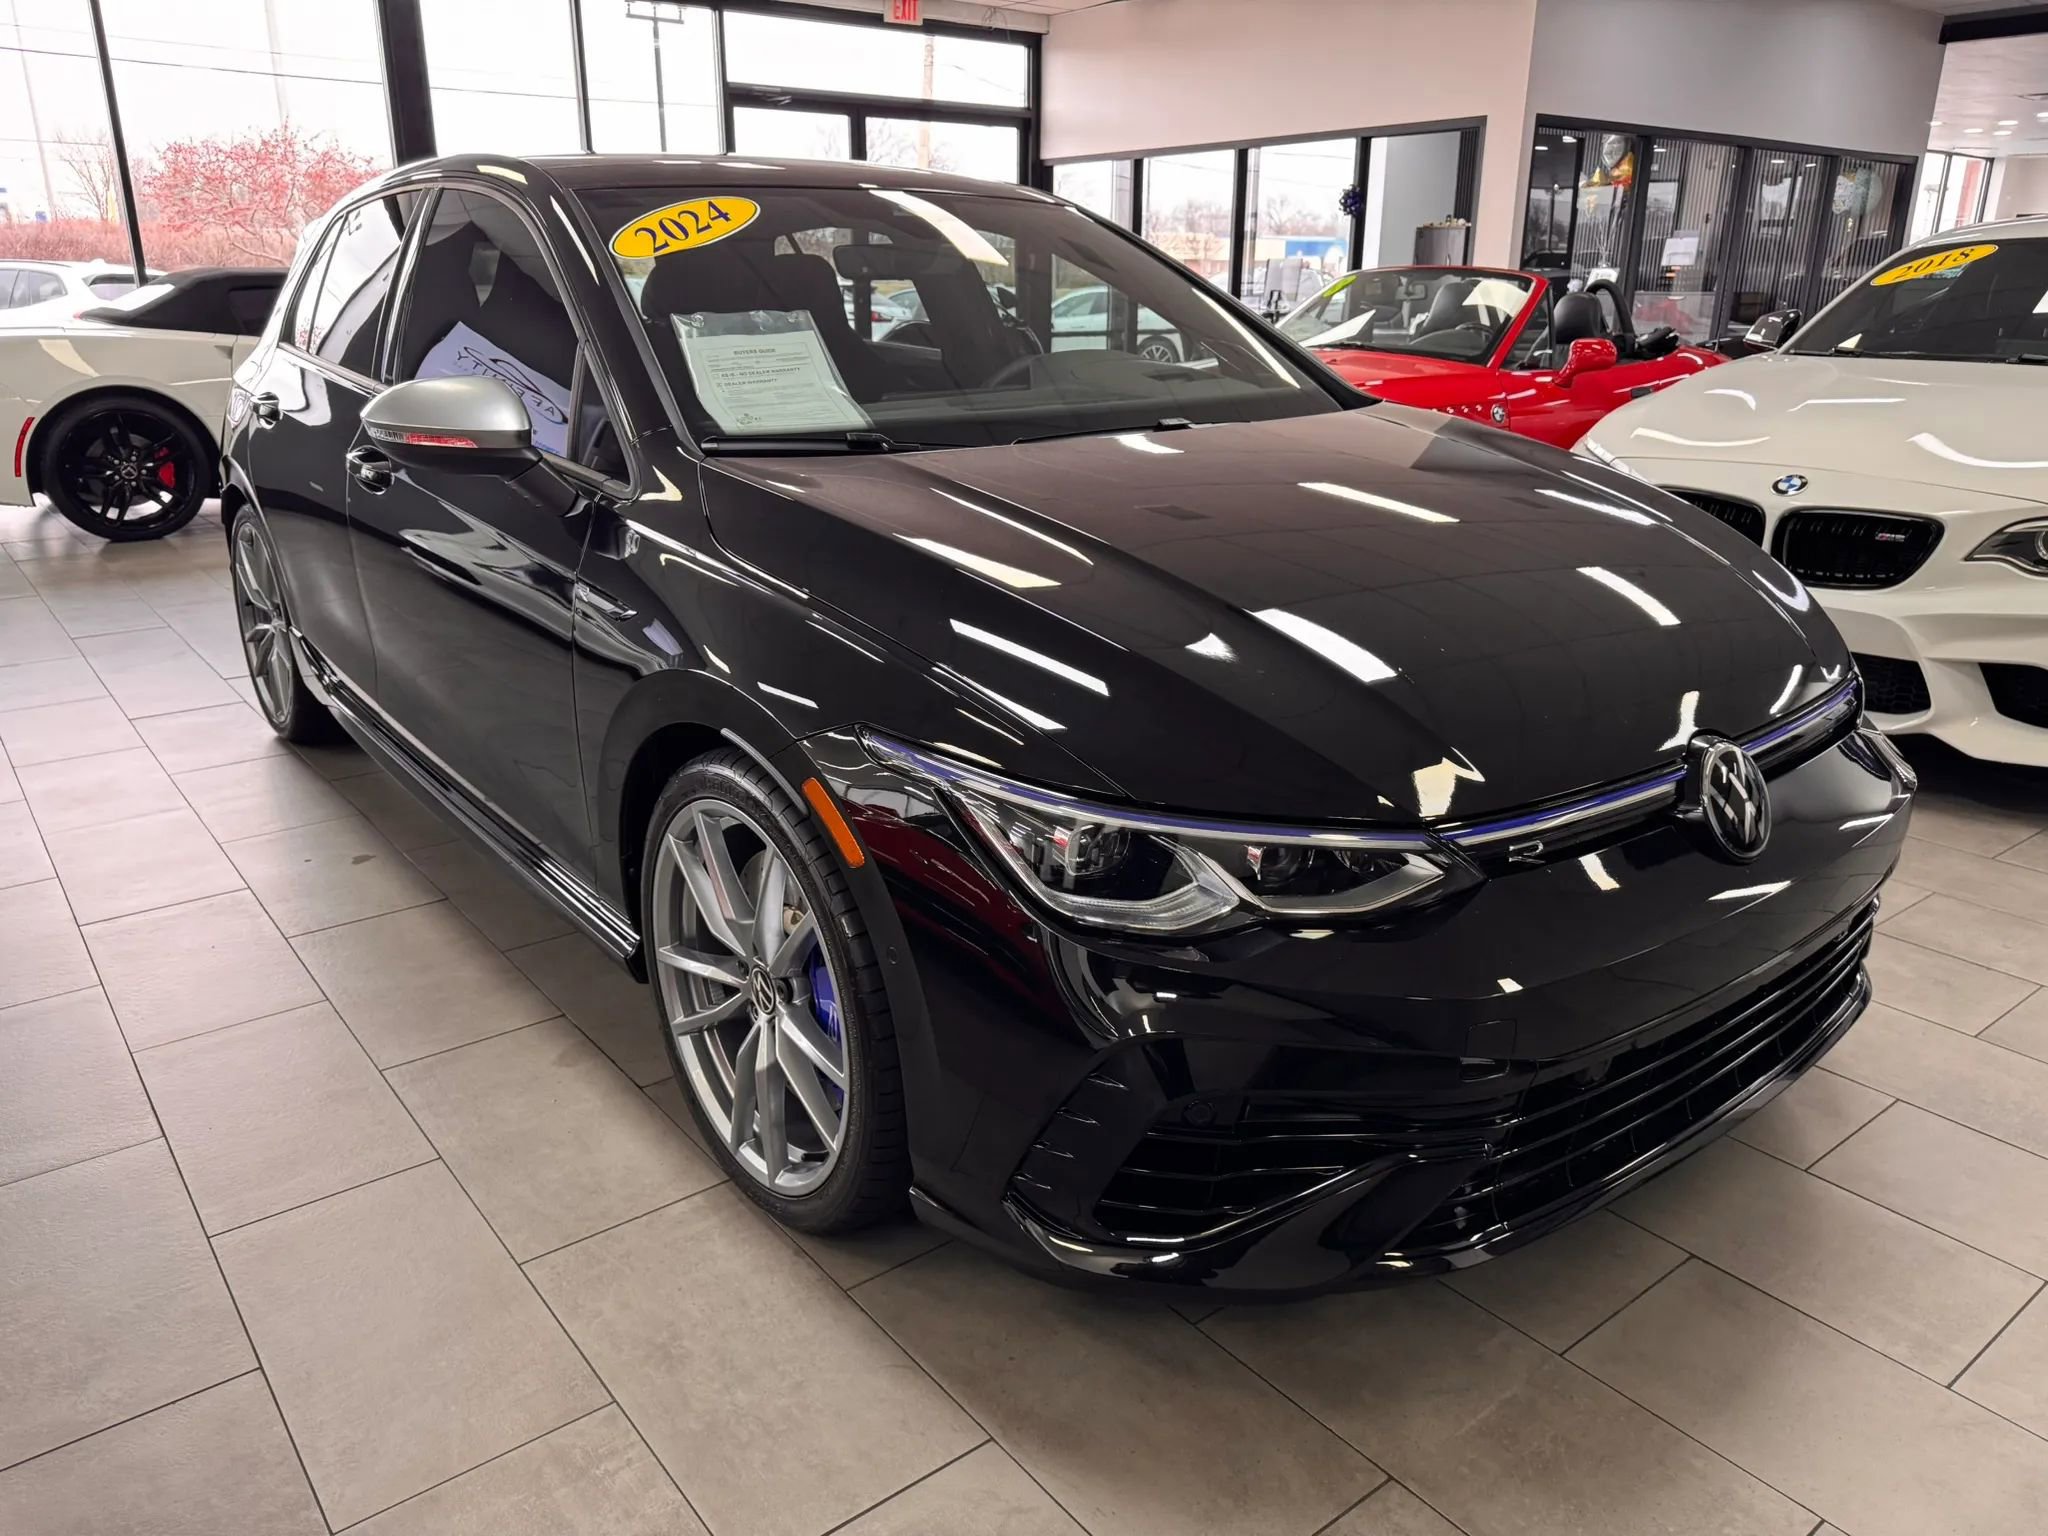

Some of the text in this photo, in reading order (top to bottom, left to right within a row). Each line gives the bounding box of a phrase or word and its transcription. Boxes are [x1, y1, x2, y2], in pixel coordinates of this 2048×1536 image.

[892, 0, 919, 21] EXIT
[634, 200, 732, 253] 2024
[1893, 248, 1975, 279] 2018
